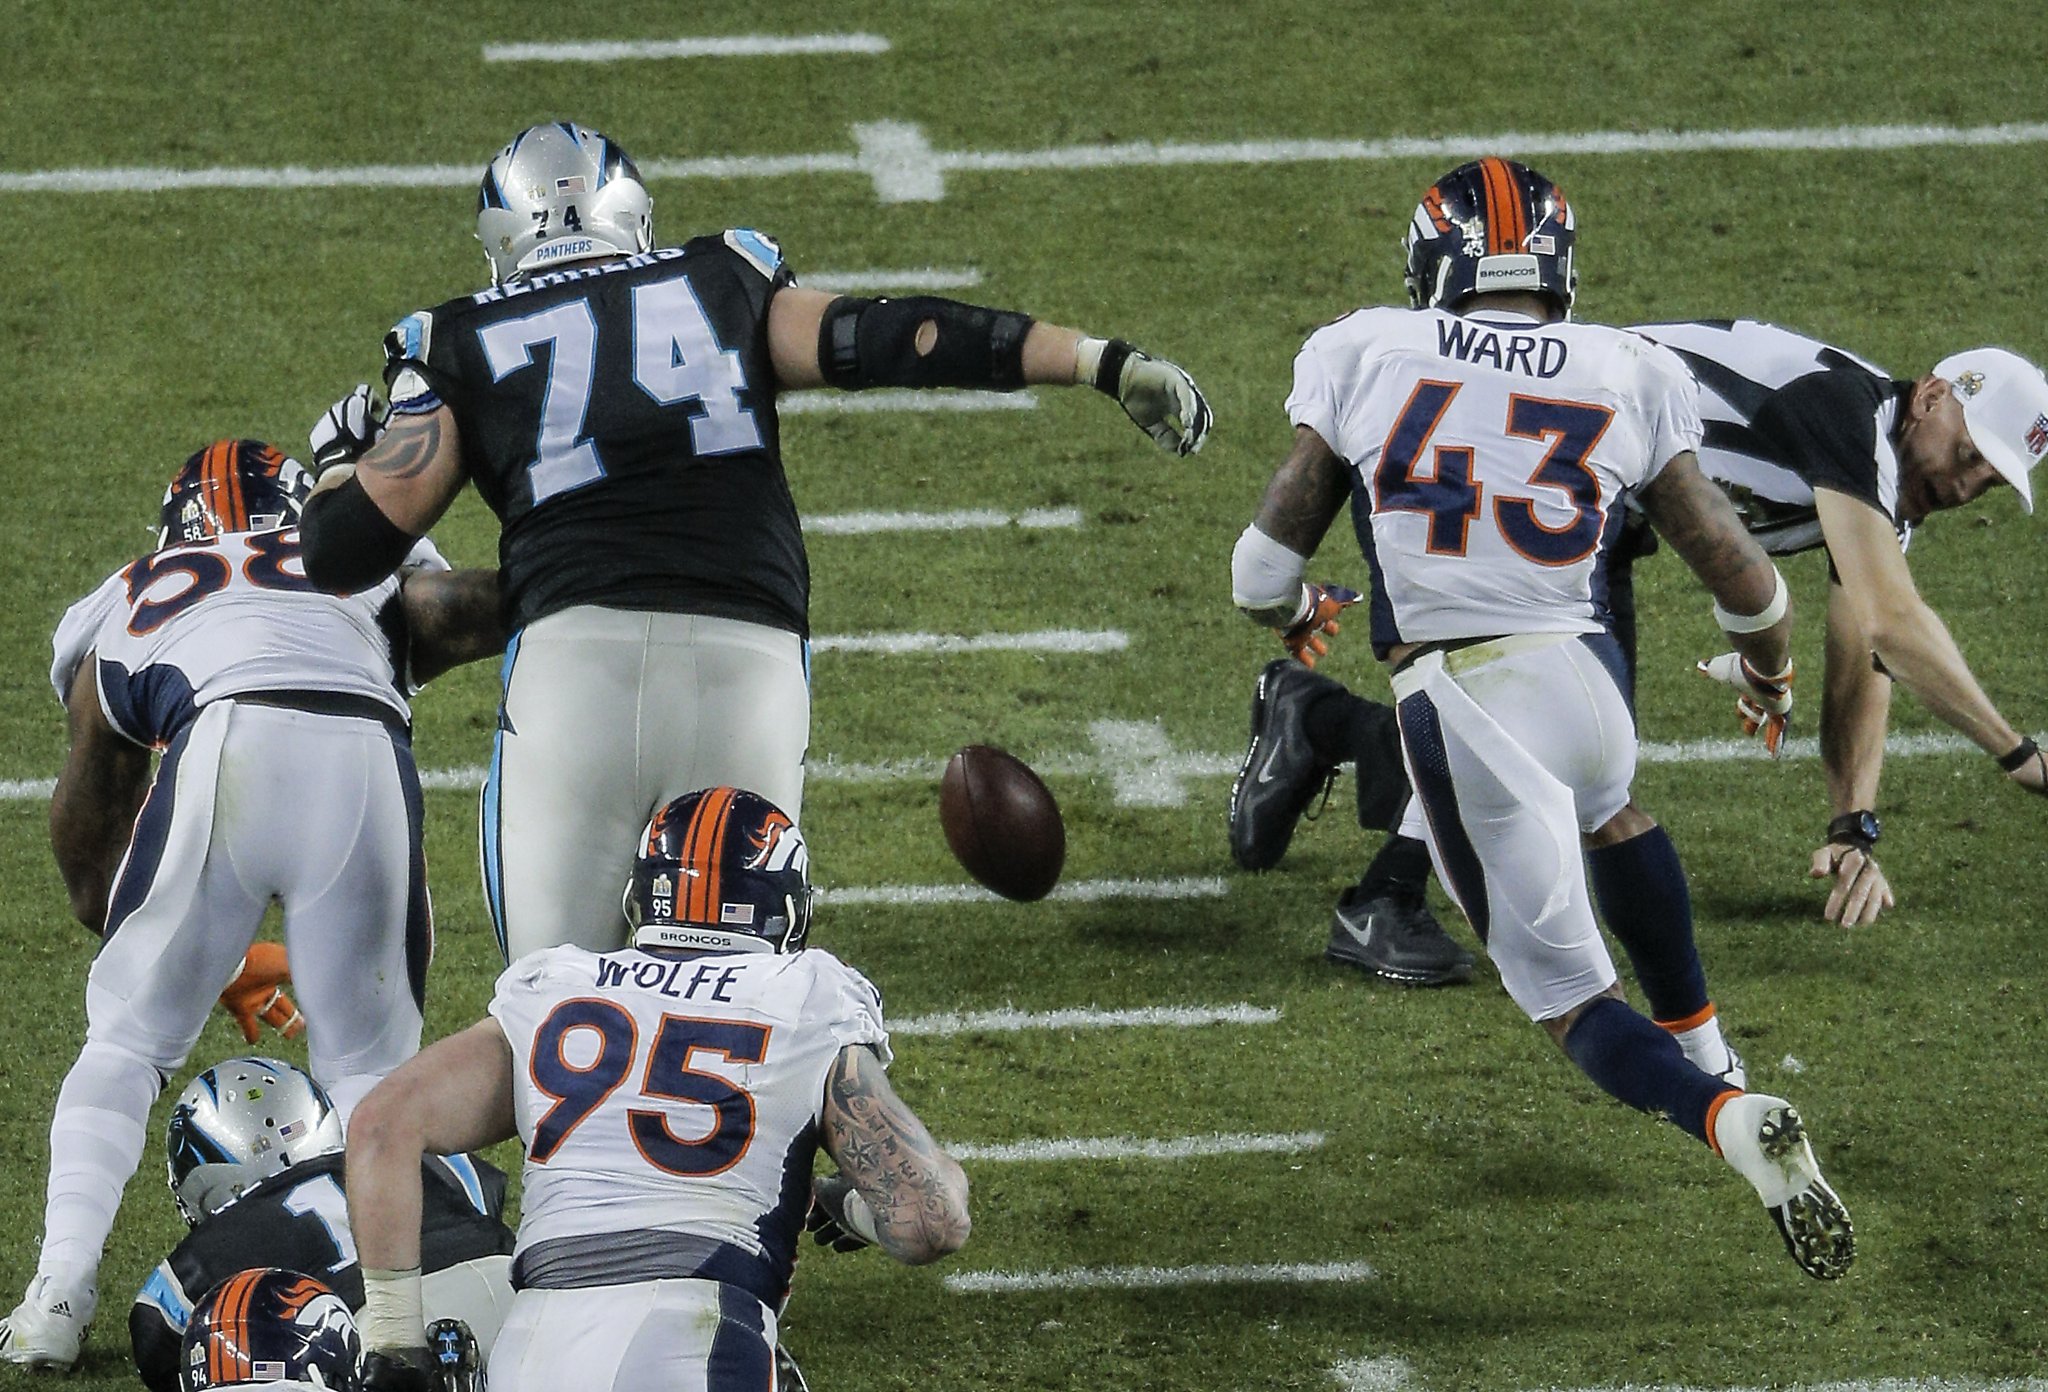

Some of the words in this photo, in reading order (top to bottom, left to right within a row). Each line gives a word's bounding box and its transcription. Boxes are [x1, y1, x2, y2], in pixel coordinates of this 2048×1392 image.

[532, 205, 582, 238] 74
[537, 240, 592, 261] PANTHERS
[1462, 240, 1484, 258] 43
[1480, 267, 1536, 278] BRONCOS
[1438, 320, 1567, 378] WARD
[478, 275, 764, 506] 74
[1374, 379, 1615, 567] 43
[183, 526, 201, 542] 58
[653, 898, 671, 917] 95
[660, 932, 731, 946] BRONCOS
[596, 957, 747, 1003] WOLFE
[529, 997, 772, 1177] 95
[191, 1367, 207, 1387] 94
